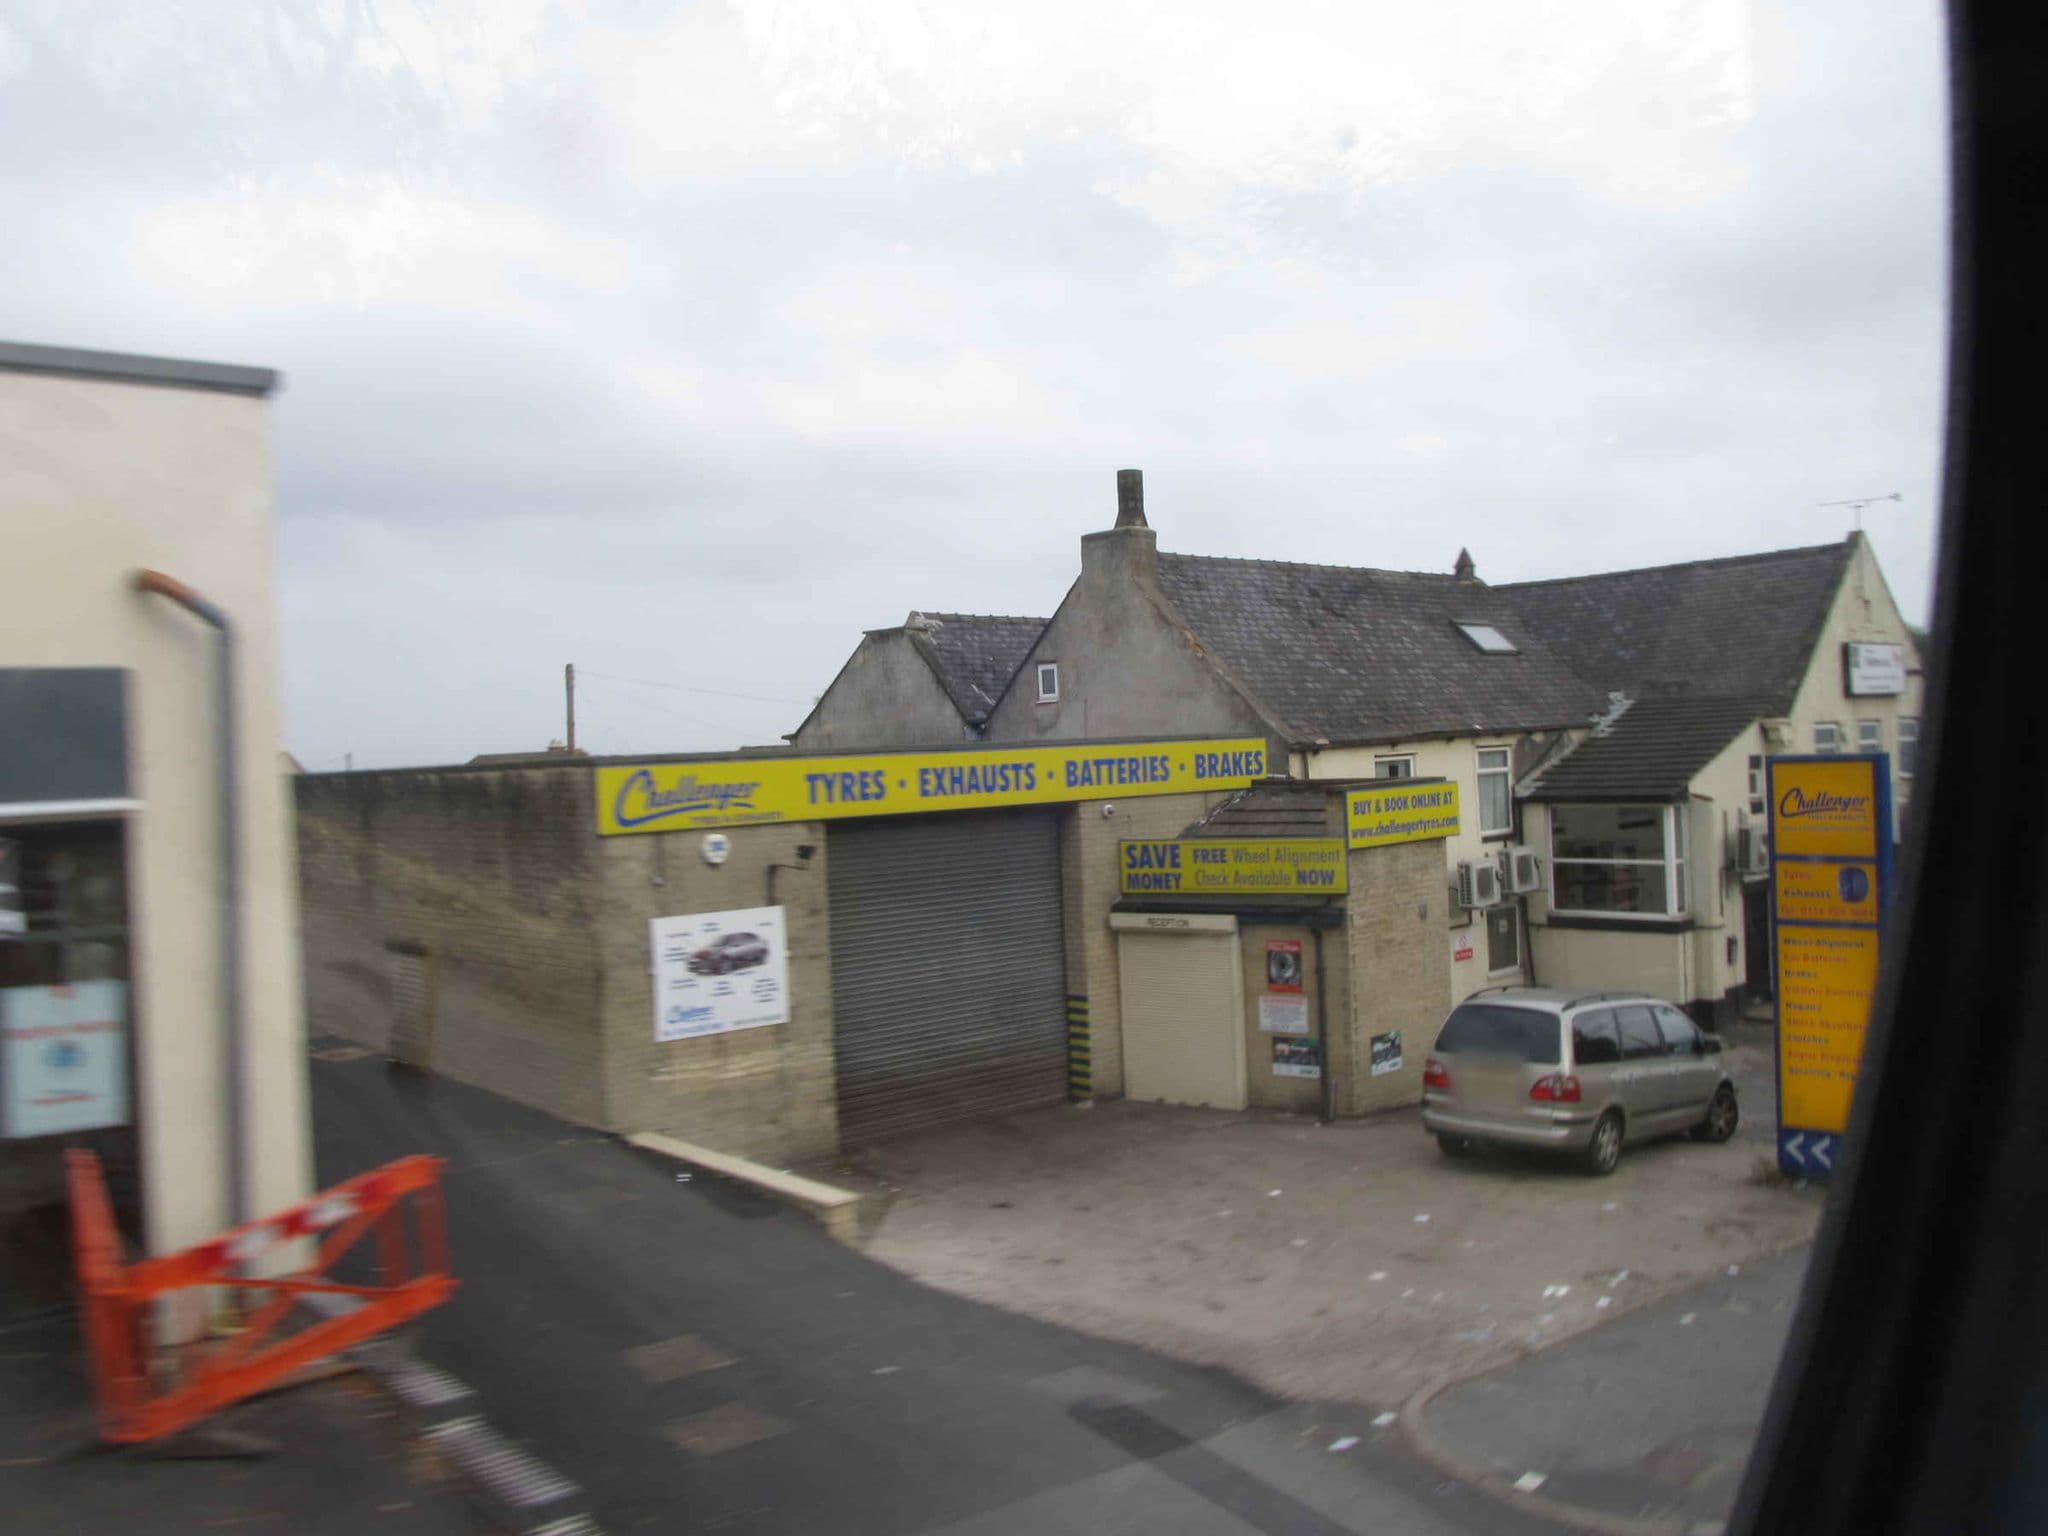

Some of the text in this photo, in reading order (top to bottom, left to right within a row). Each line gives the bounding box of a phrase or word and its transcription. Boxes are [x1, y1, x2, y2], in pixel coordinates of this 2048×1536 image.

[804, 749, 1264, 805] TYRES EXHAUSTS BATTERIES BRAKES
[1353, 799, 1371, 816] BUY
[1384, 796, 1409, 812] BOOK
[1411, 793, 1440, 809] ONLINE
[1780, 787, 1869, 818] Challenger
[1126, 844, 1181, 869] SAVE
[1193, 848, 1341, 866] FREE Wheel Alignment
[1127, 872, 1182, 890] MONEY
[1195, 869, 1335, 886] Check Available NOW
